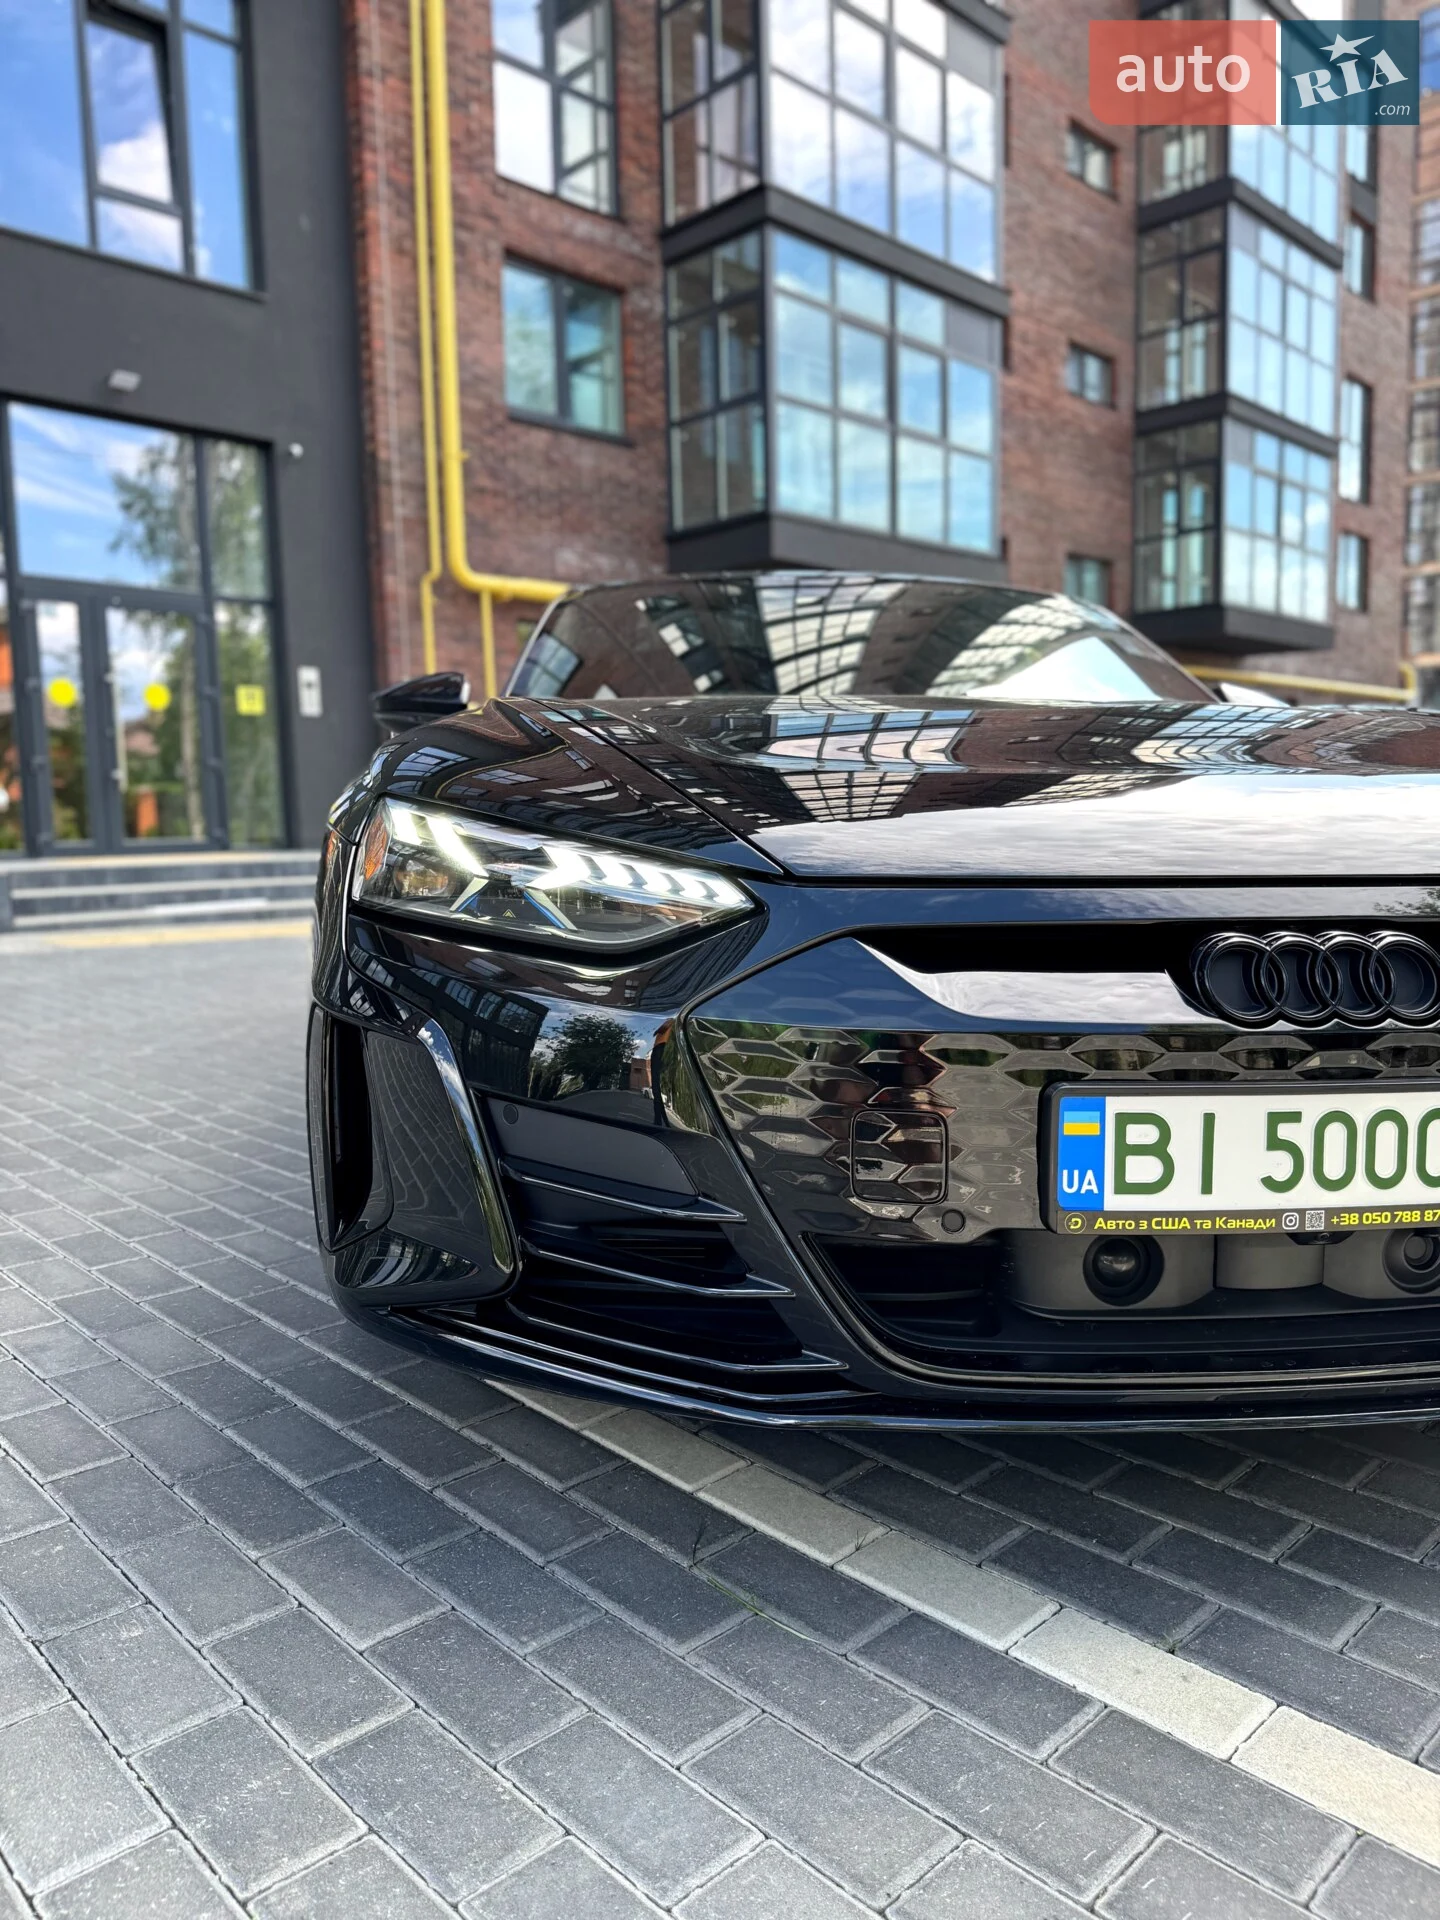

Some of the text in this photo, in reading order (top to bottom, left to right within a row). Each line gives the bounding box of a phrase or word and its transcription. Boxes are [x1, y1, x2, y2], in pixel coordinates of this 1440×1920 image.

[1062, 1169, 1099, 1194] UA
[1094, 1216, 1276, 1230] Авто з США та Канади
[1330, 1213, 1359, 1226] +38
[1362, 1211, 1391, 1225] 050
[1393, 1210, 1421, 1224] 788
